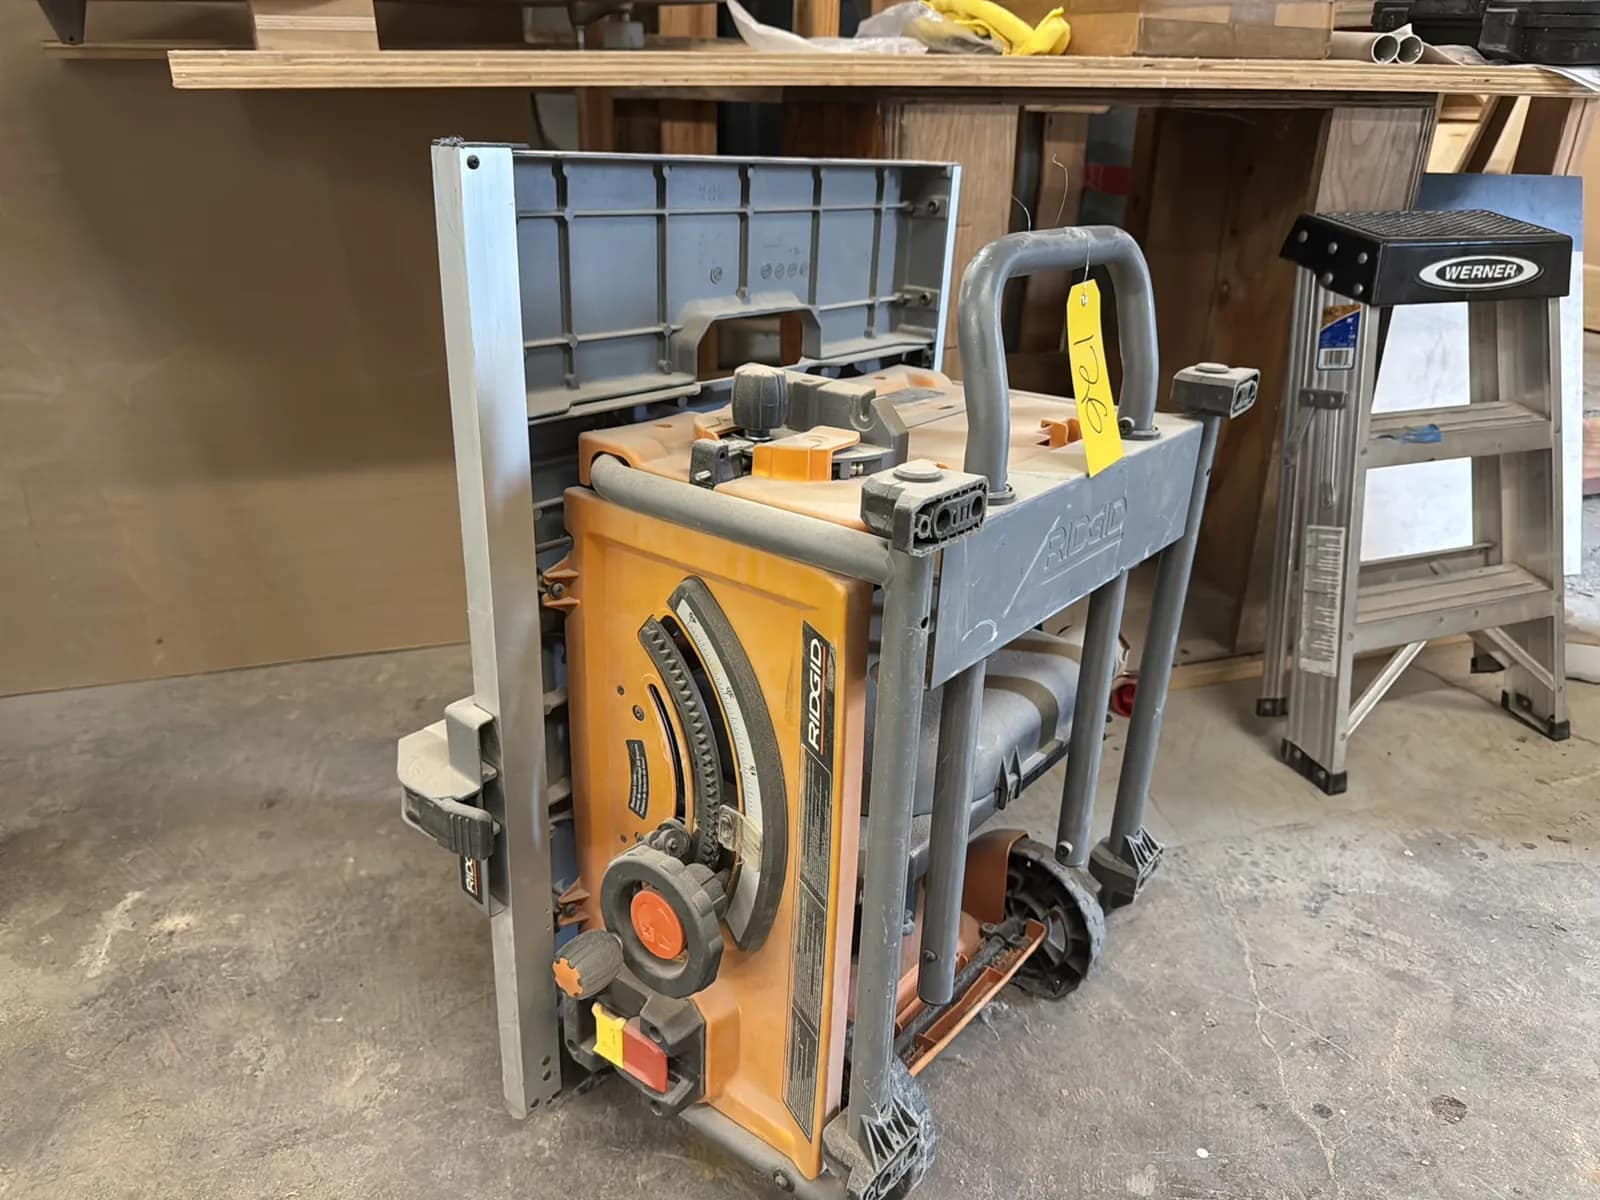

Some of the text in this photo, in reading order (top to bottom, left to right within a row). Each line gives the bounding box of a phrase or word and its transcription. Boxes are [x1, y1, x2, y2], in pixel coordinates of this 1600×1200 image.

[1445, 264, 1517, 281] WERNER
[1073, 334, 1108, 434] 126
[1043, 496, 1127, 571] RIDGID
[808, 638, 822, 751] RIDGID
[465, 856, 475, 893] RID
